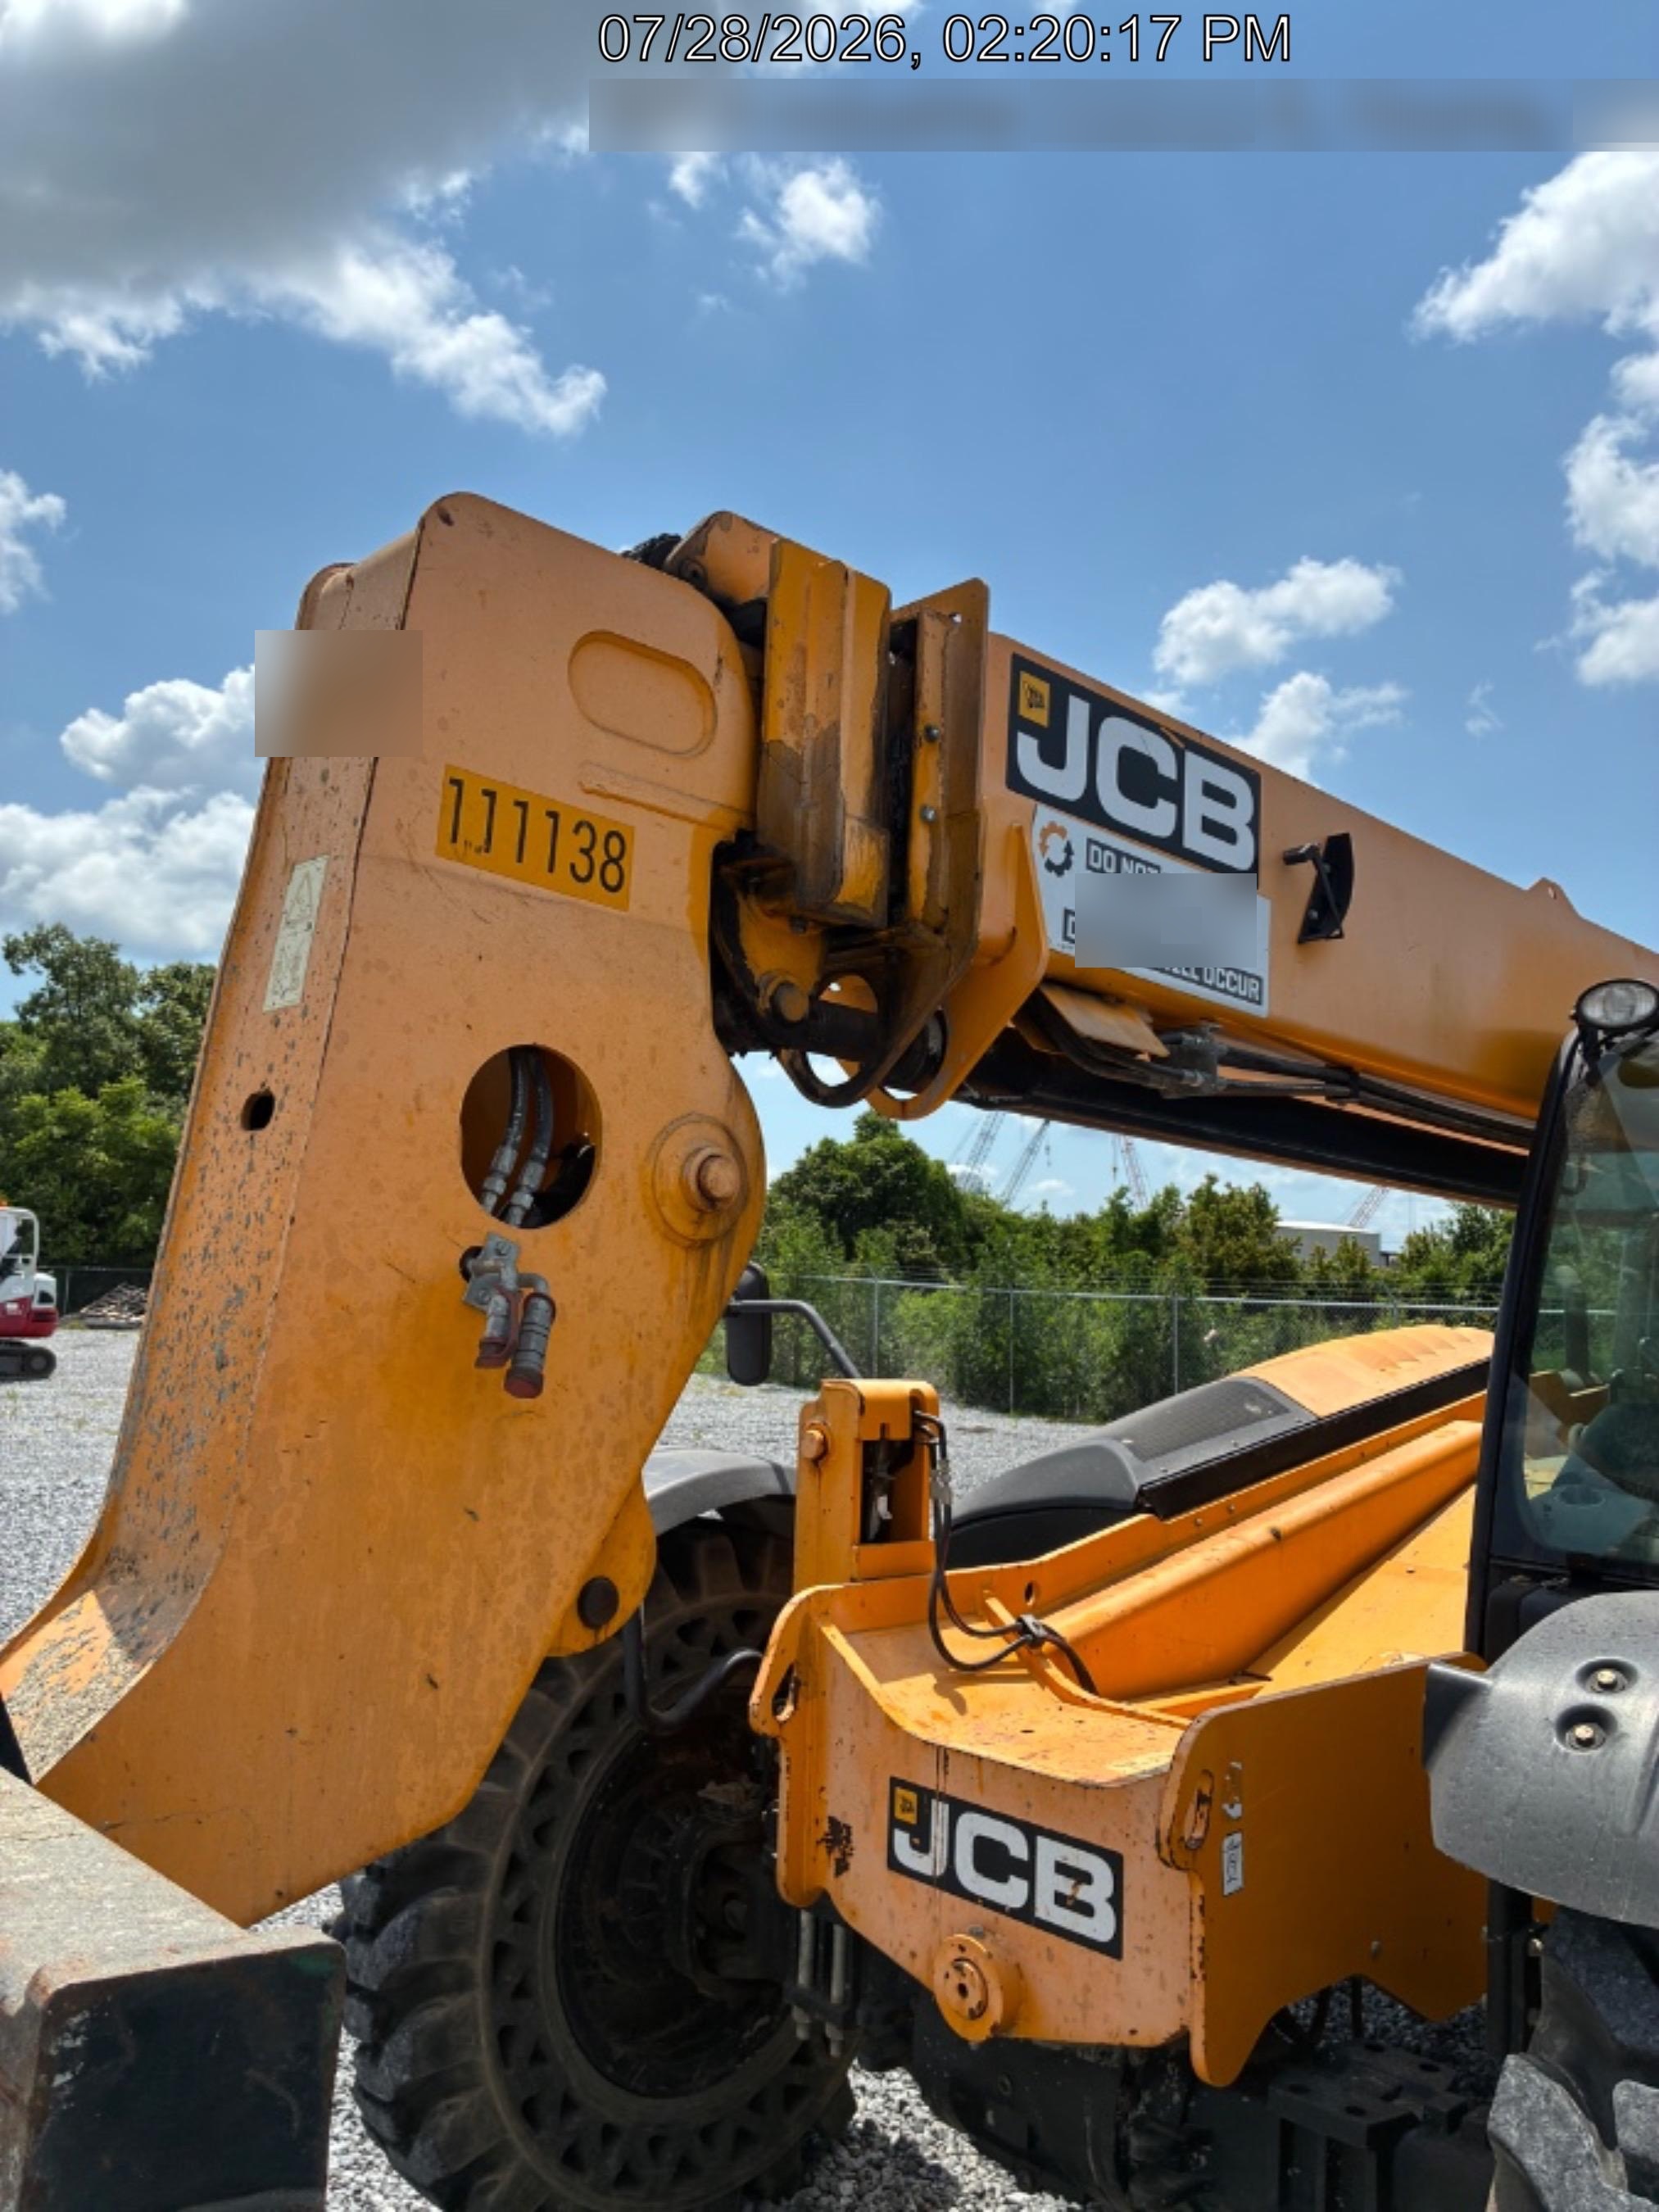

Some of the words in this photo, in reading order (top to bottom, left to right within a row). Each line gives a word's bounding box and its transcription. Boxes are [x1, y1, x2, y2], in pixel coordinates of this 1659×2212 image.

[448, 776, 626, 893] 111138
[1017, 694, 1255, 872] JCB
[1089, 843, 1117, 873] DO
[1203, 968, 1260, 1001] OCCUR
[894, 1798, 1117, 1942] JCB
